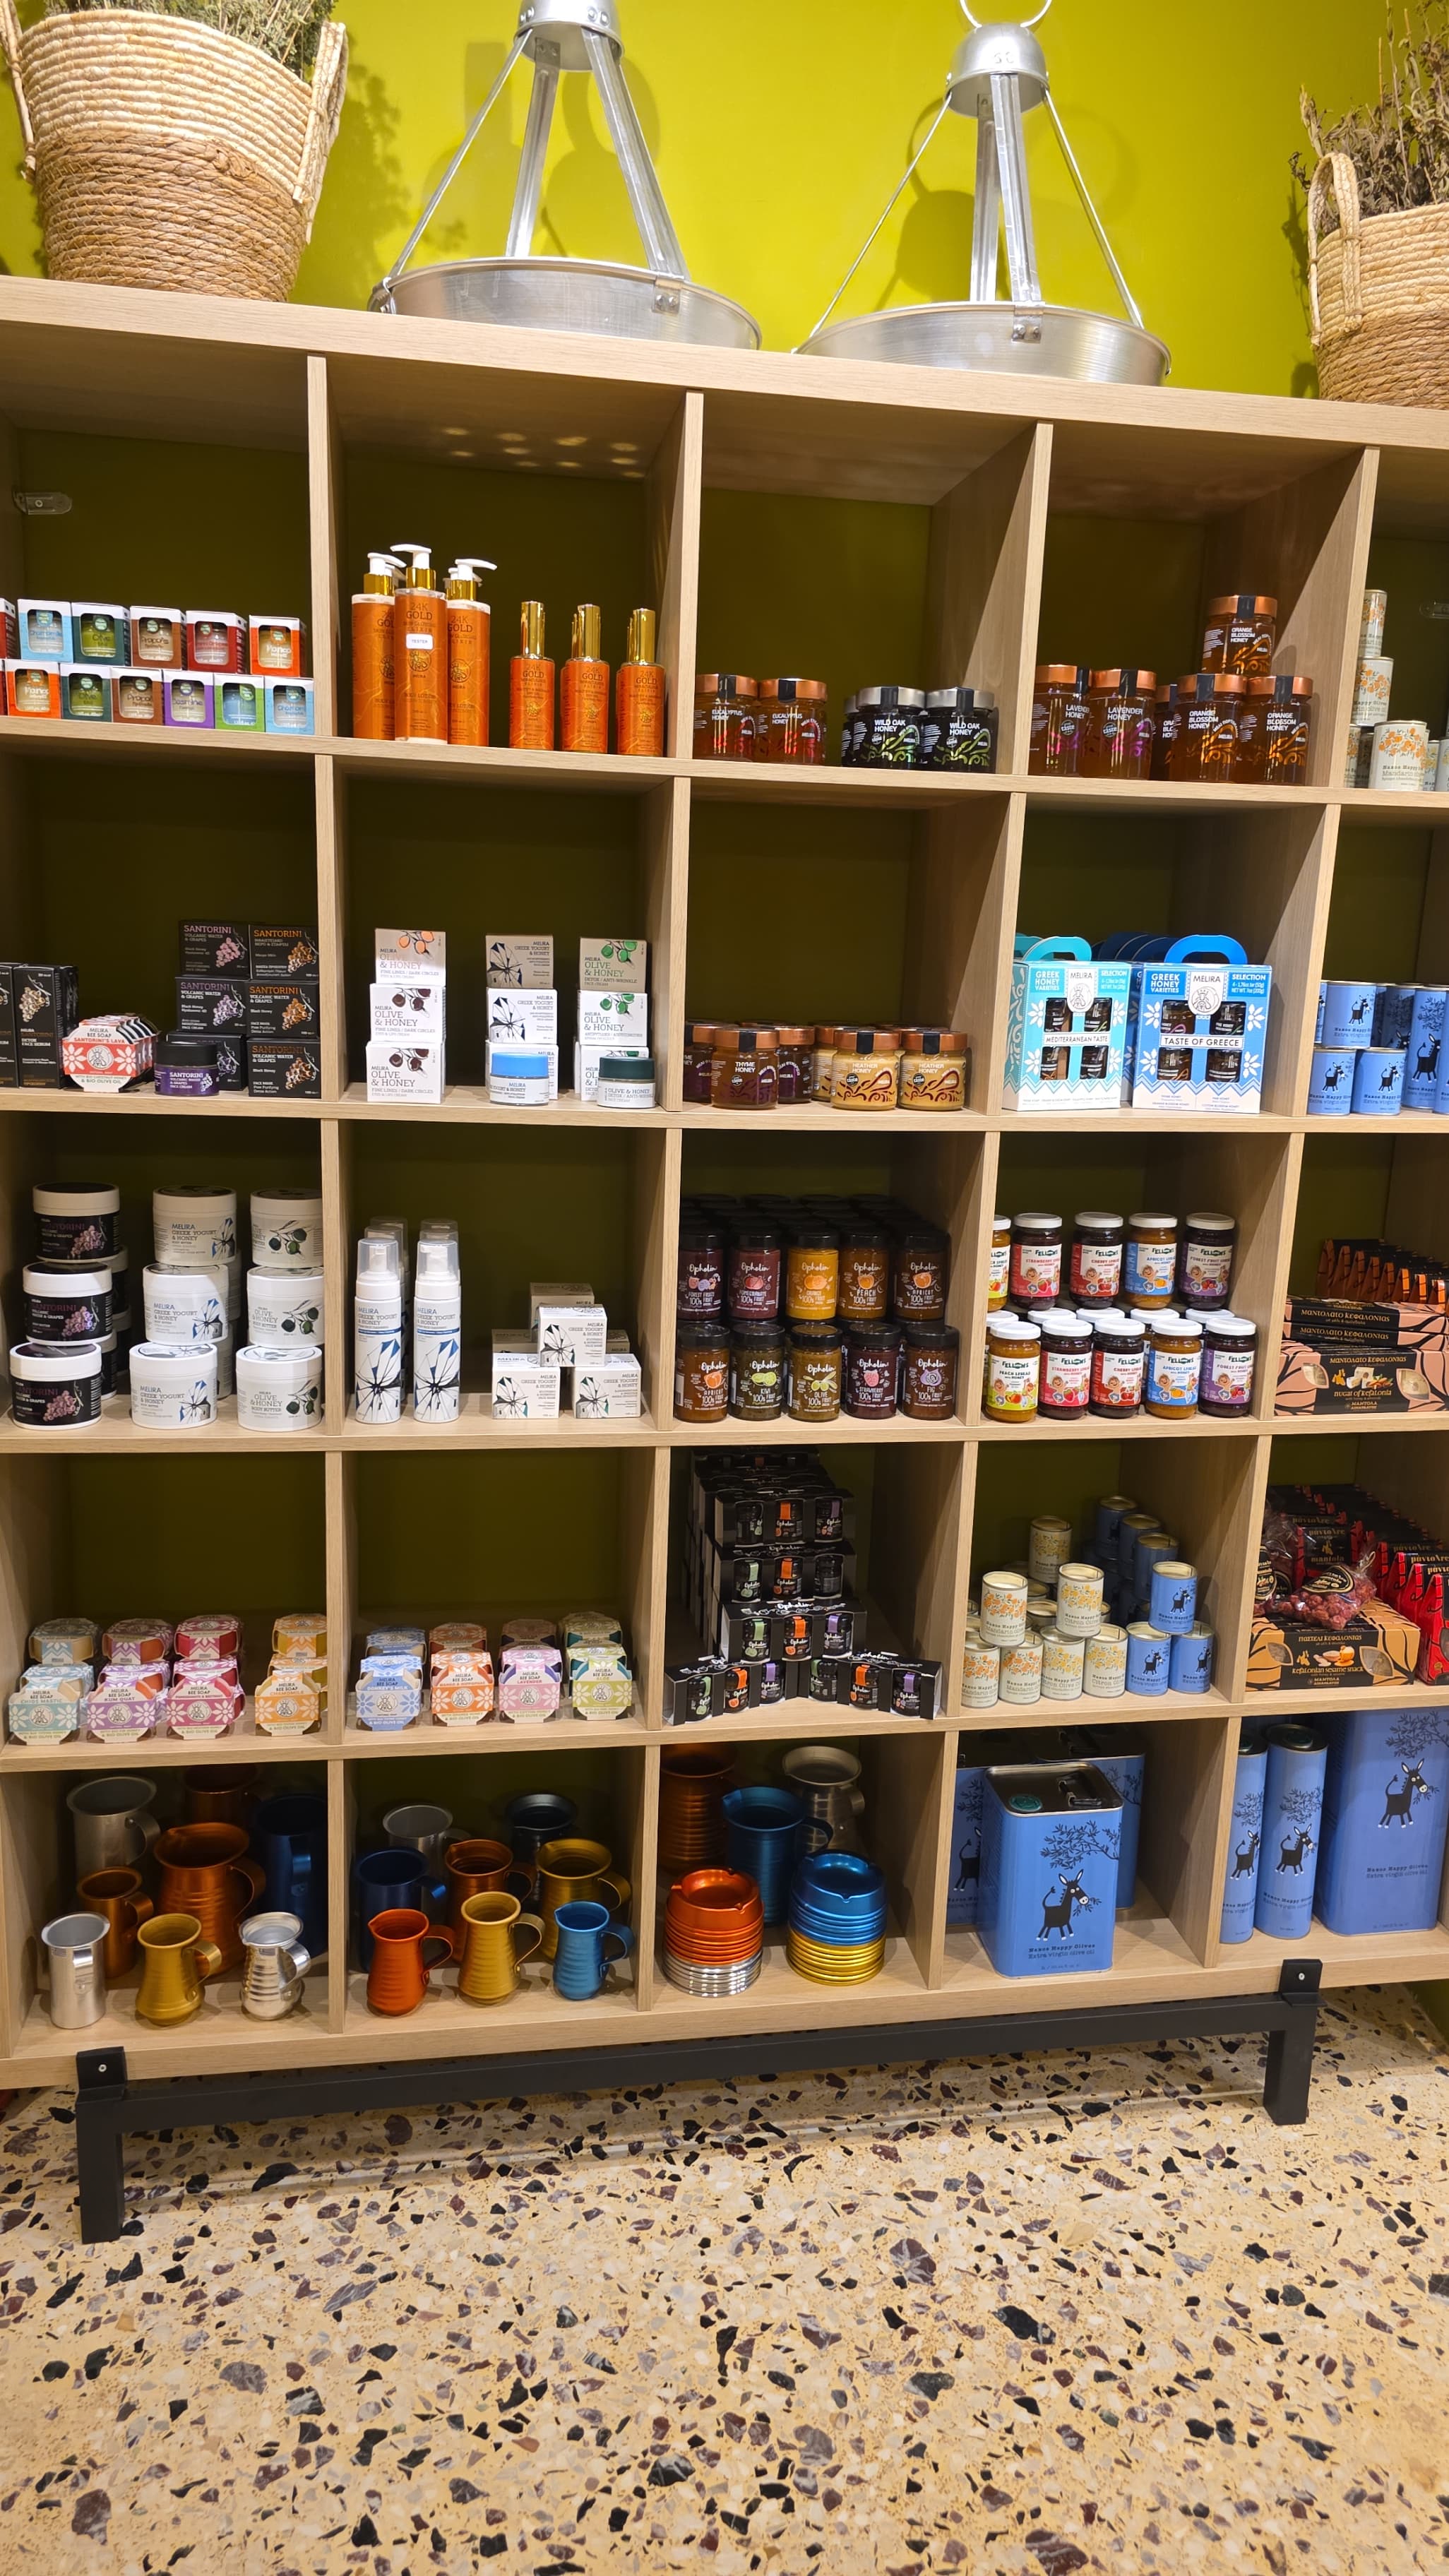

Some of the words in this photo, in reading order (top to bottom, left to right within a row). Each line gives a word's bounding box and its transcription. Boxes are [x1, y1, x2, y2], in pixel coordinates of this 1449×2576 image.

[406, 611, 432, 620] GOLD
[448, 624, 472, 632] GOLD
[184, 925, 232, 934] SANTORINI
[180, 982, 229, 991] SANTORINI
[249, 986, 299, 995] SANTORINI
[385, 1019, 417, 1027] HONEY
